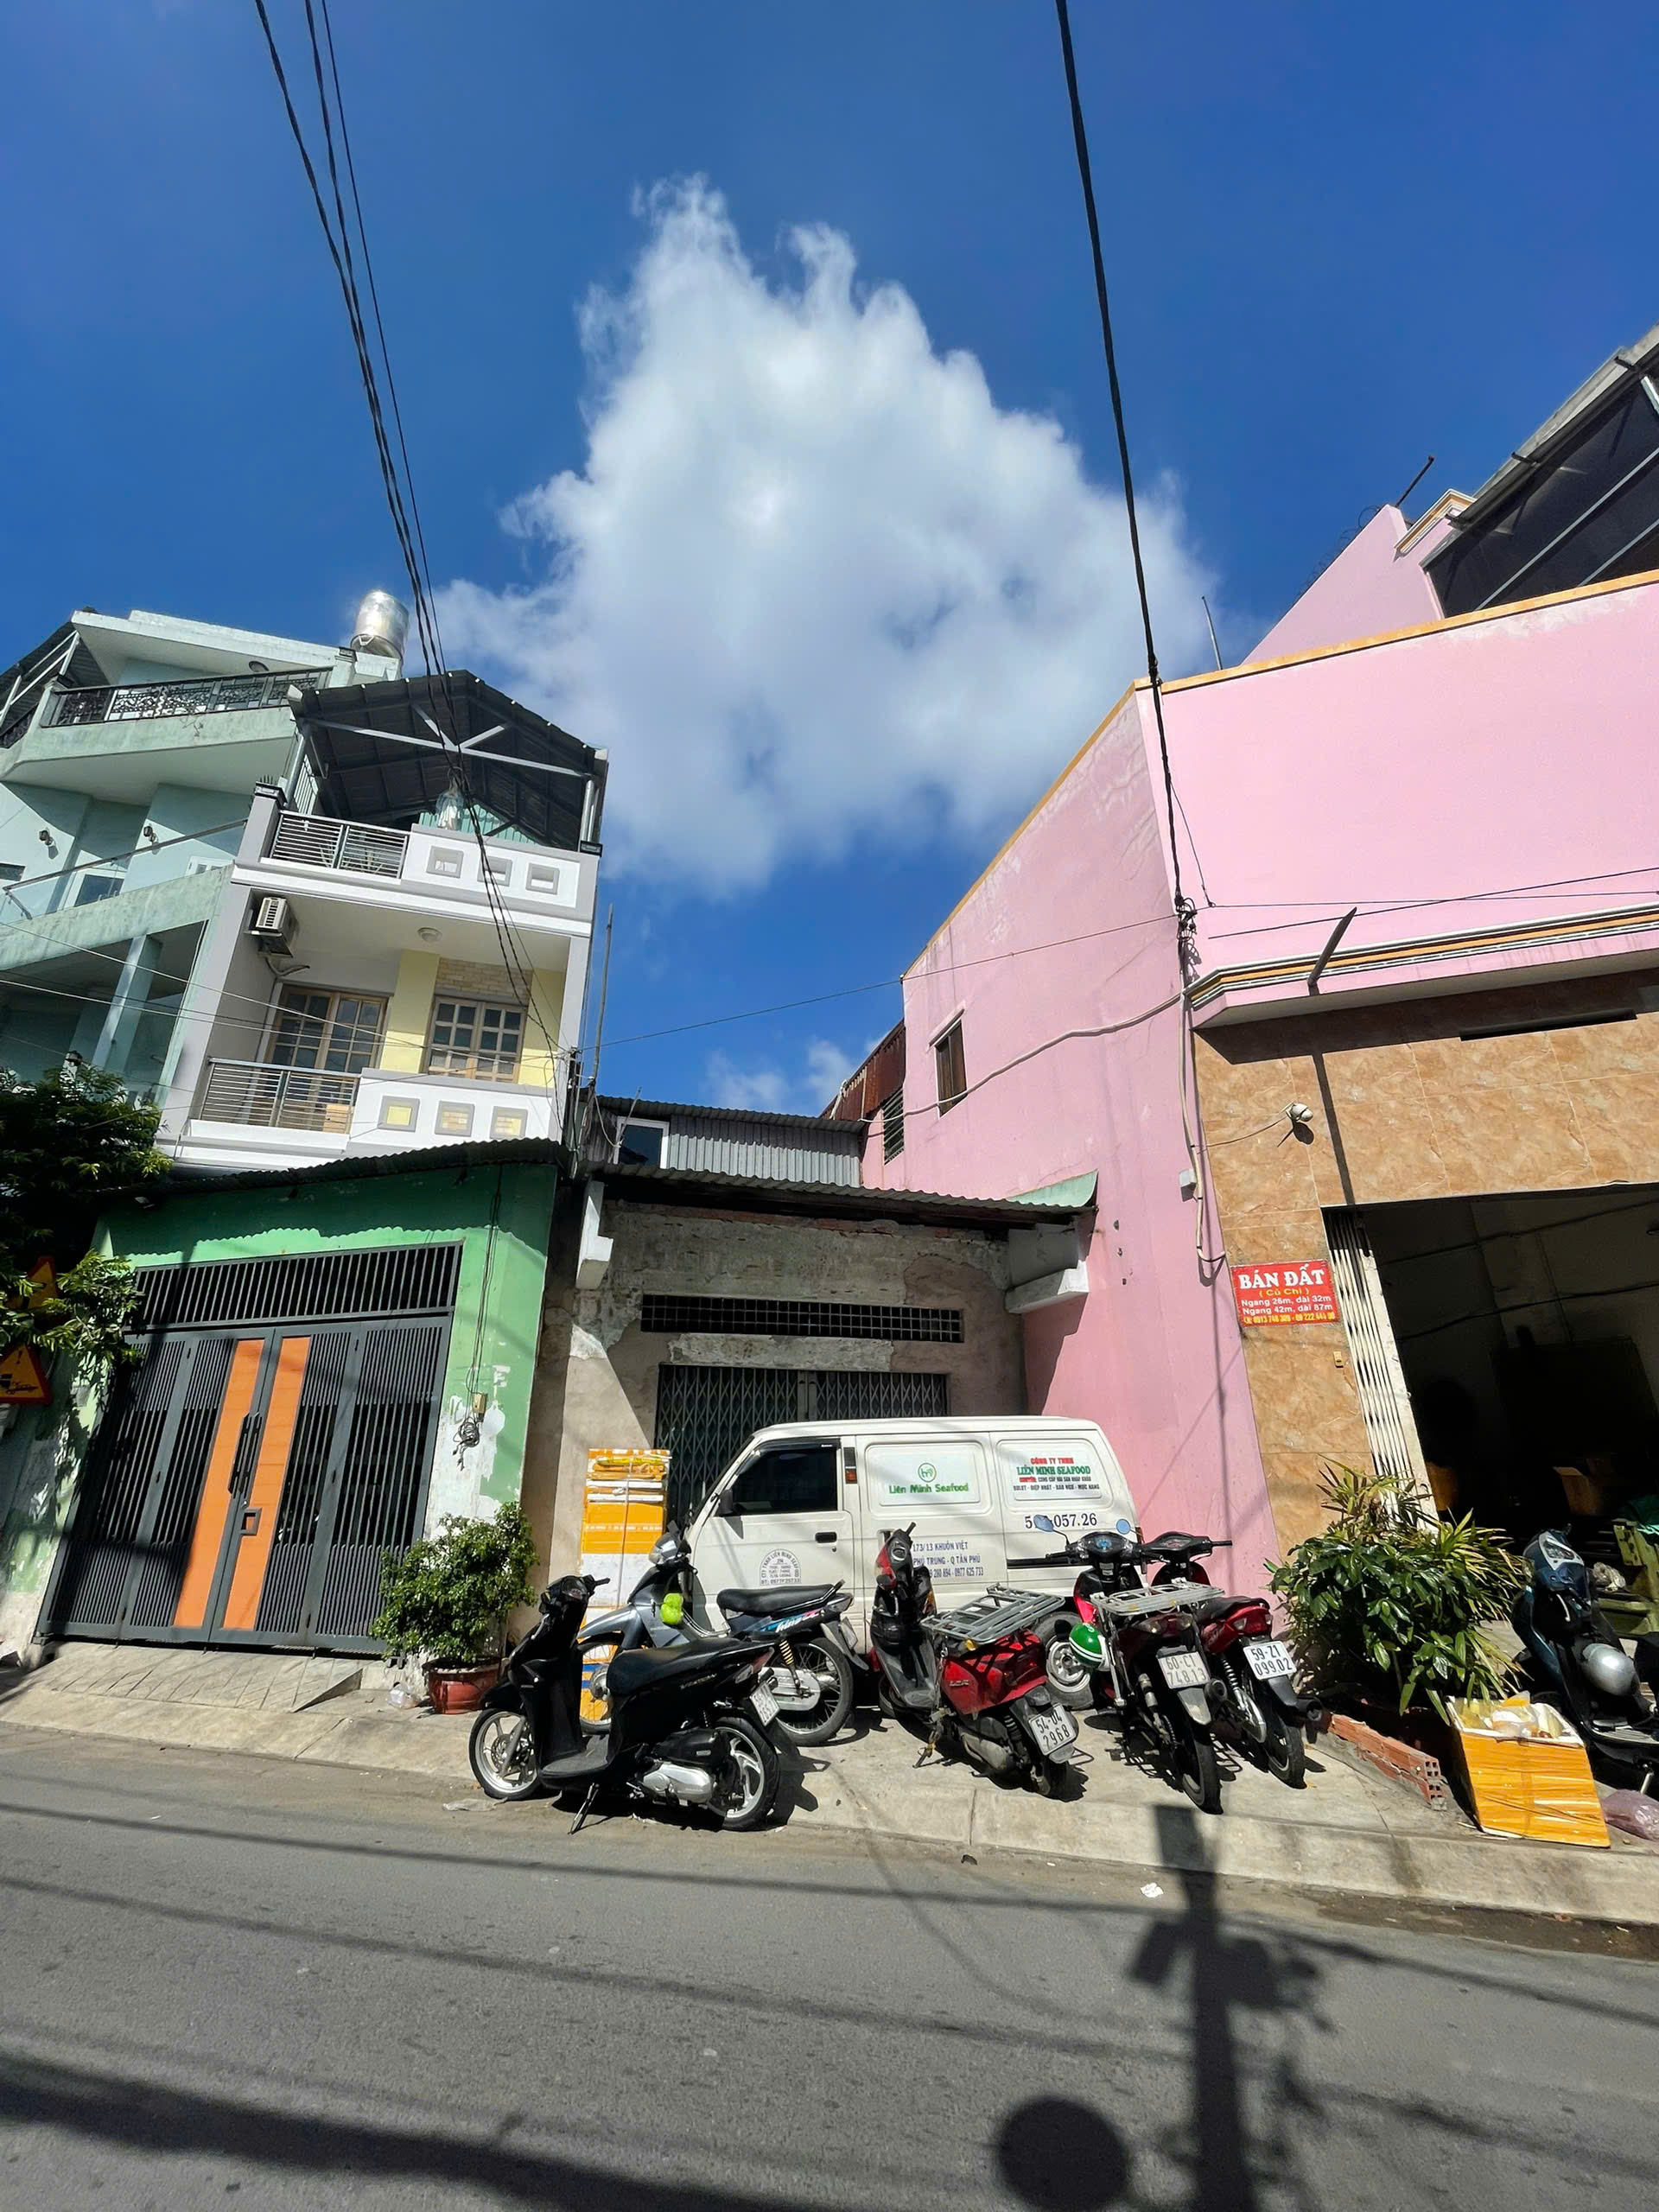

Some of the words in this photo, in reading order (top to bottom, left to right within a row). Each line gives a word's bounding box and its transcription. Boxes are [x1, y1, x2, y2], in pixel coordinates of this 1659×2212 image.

[1238, 1269, 1279, 1289] BÁN
[1284, 1263, 1325, 1286] ĐẤT
[1243, 1307, 1272, 1316] Ngang
[1016, 1464, 1033, 1476] LIÊN
[1036, 1465, 1056, 1475] MINH
[1057, 1465, 1090, 1475] SEAFOOD
[888, 1484, 906, 1494] Liên
[910, 1484, 931, 1493] Minh
[935, 1483, 969, 1492] Seafood
[950, 1556, 955, 1565] Q
[956, 1554, 968, 1564] TÂN
[1251, 1645, 1281, 1661] 59-Z1
[1255, 1657, 1293, 1676] 099.02
